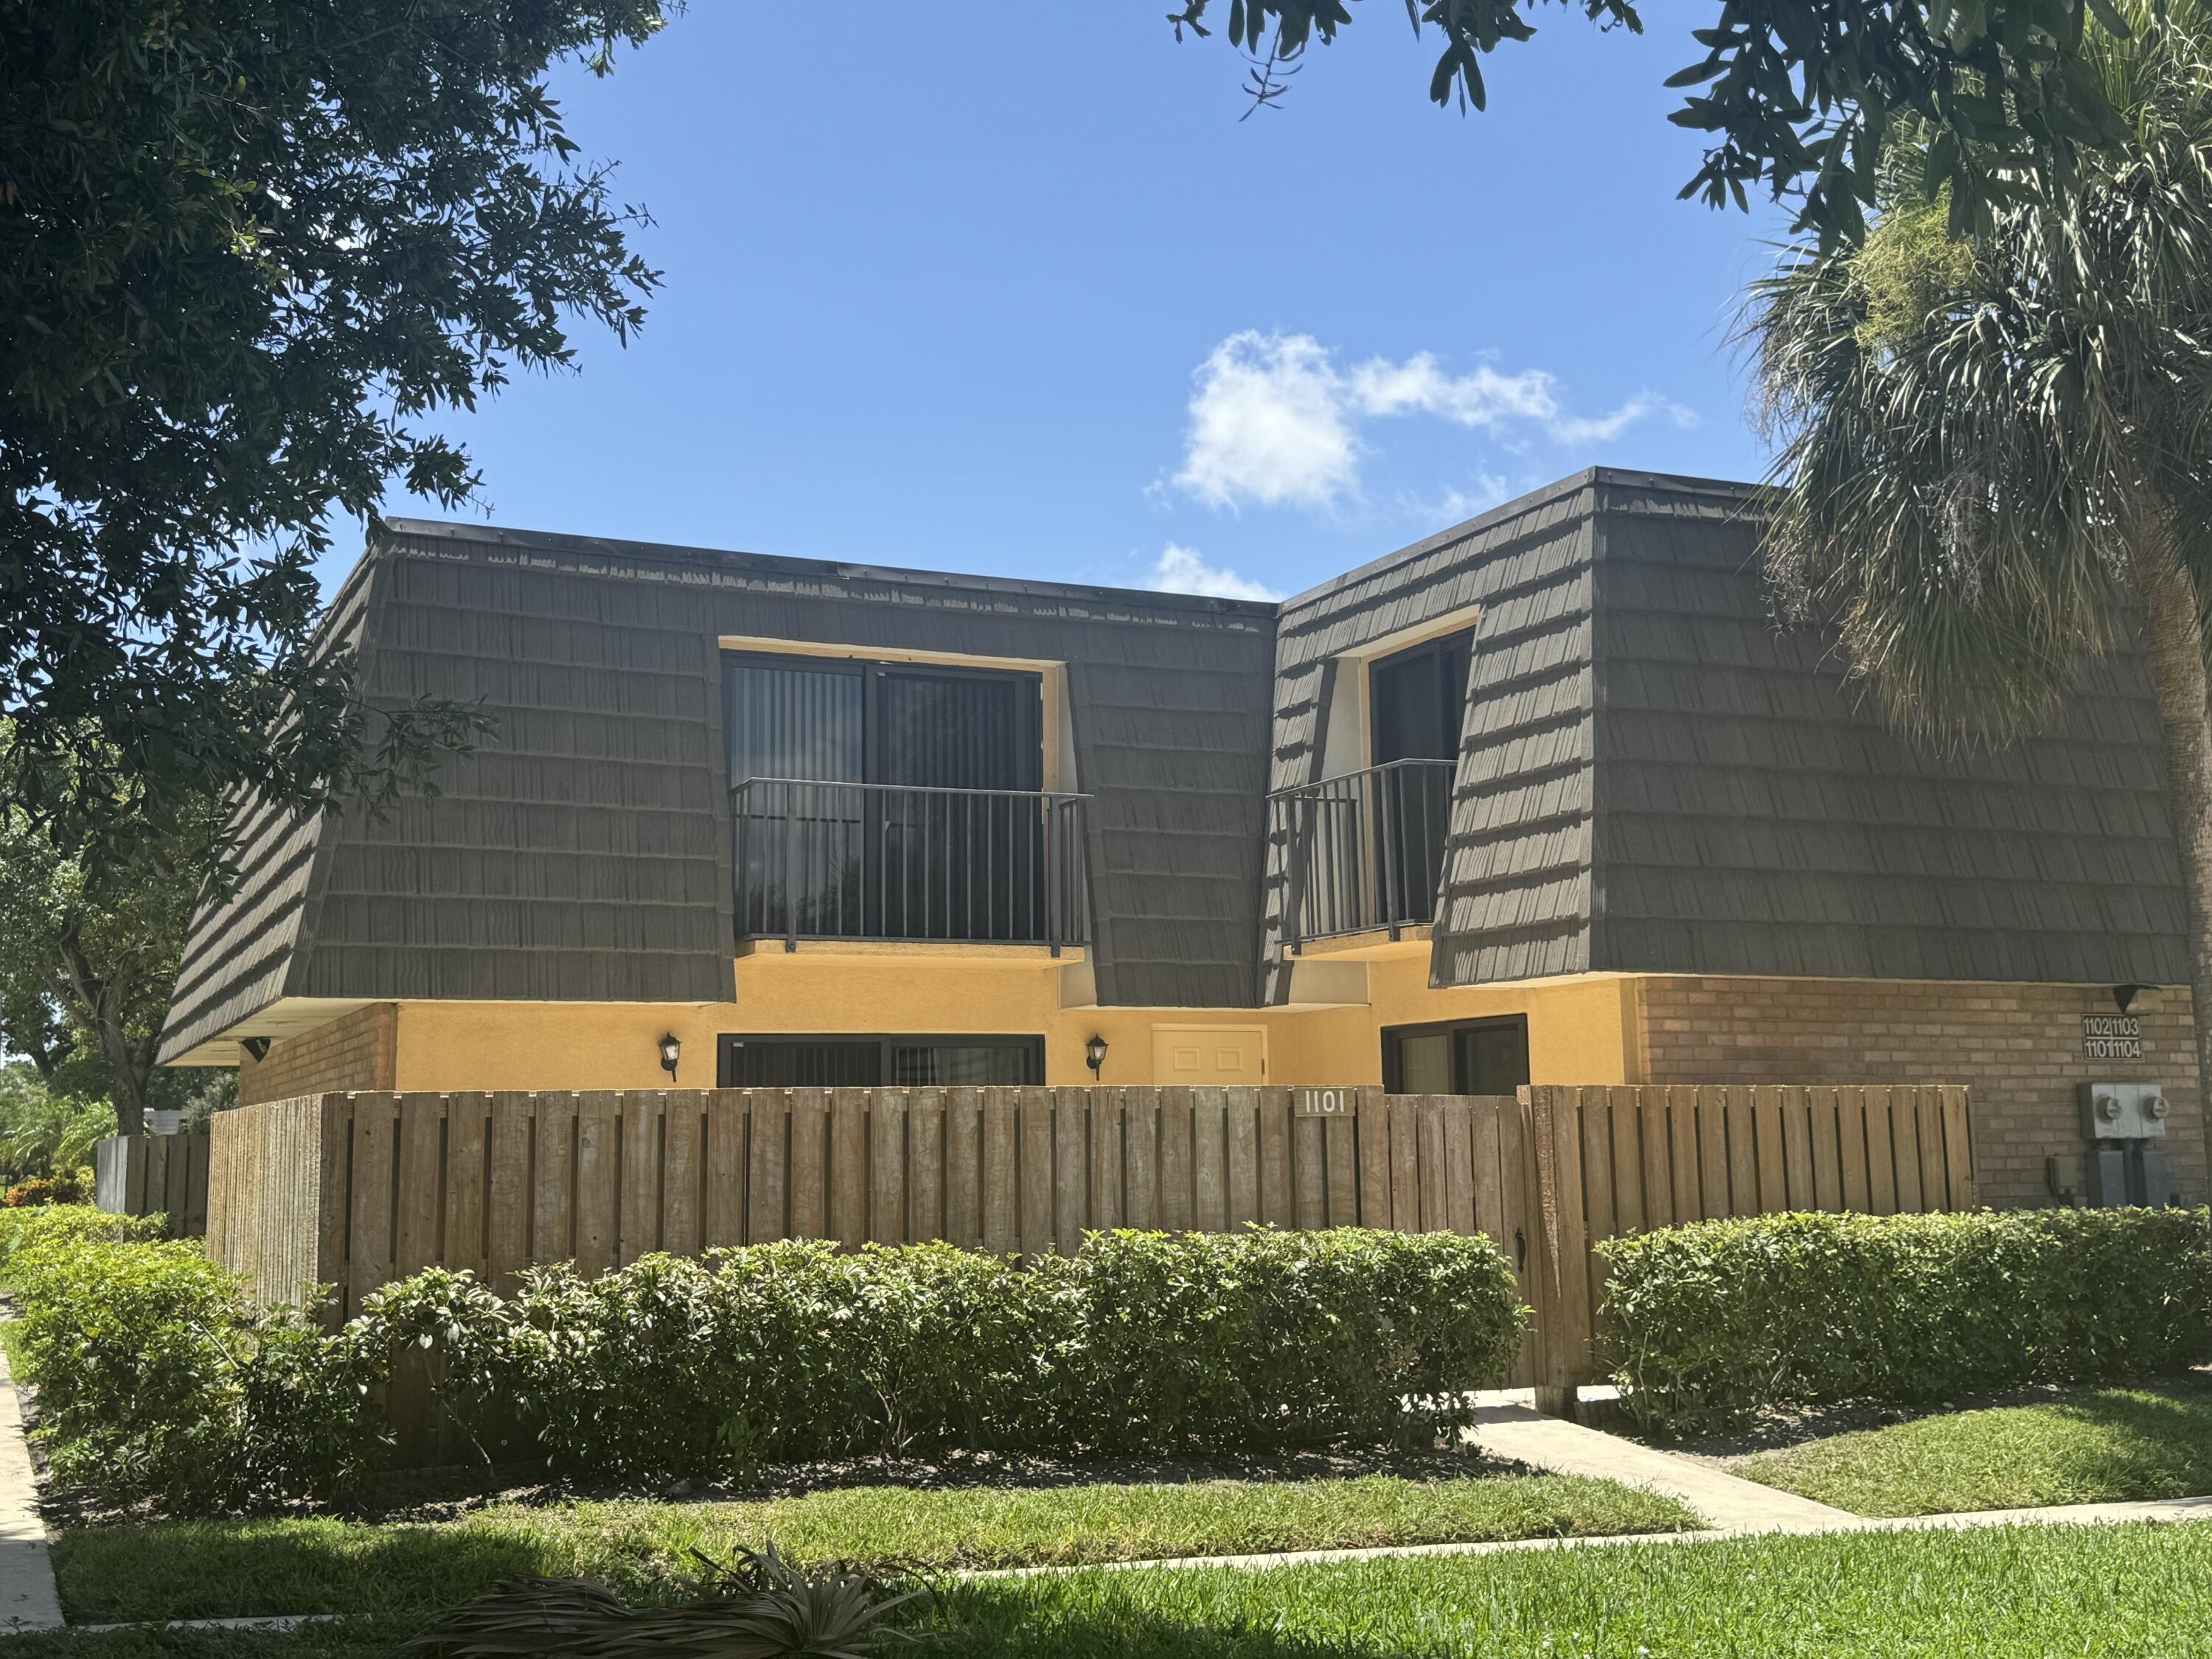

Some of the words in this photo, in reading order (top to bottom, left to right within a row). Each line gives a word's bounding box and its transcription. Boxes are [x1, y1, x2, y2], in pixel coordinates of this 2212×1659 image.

[2084, 1018, 2110, 1034] 1102
[2112, 1018, 2138, 1035] 1103
[2085, 1040, 2112, 1057] 1101
[2114, 1040, 2141, 1057] 1104
[1305, 1090, 1344, 1113] 1101
